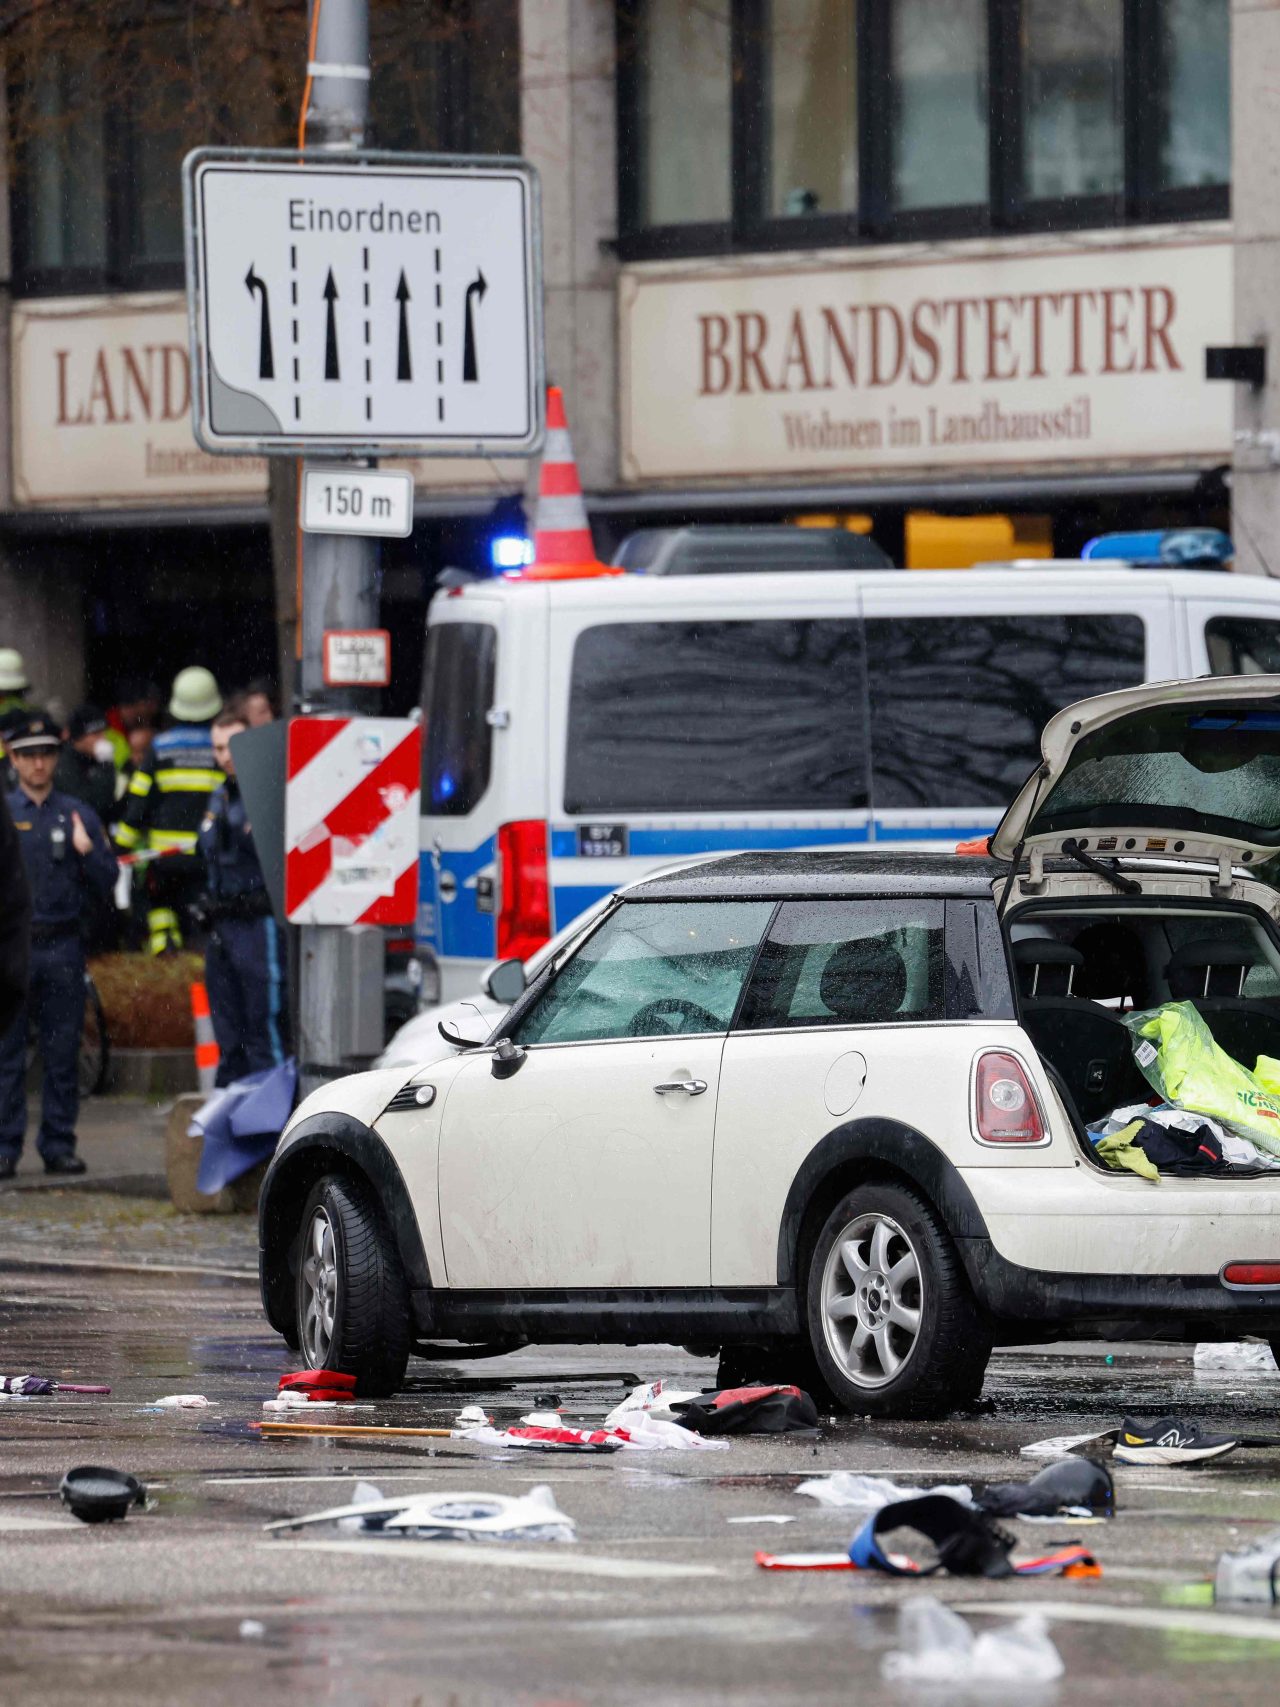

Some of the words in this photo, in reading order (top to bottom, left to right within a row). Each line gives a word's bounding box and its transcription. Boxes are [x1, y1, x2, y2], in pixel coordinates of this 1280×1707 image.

[289, 198, 442, 233] Einordnen
[697, 284, 1183, 397] BRANDSTETTER
[55, 344, 204, 426] LAND
[783, 408, 882, 452] Wohnen
[888, 404, 922, 447] im
[927, 397, 1092, 445] Landhausstil
[324, 485, 364, 517] 150
[371, 496, 392, 518] m
[589, 827, 614, 840] BY
